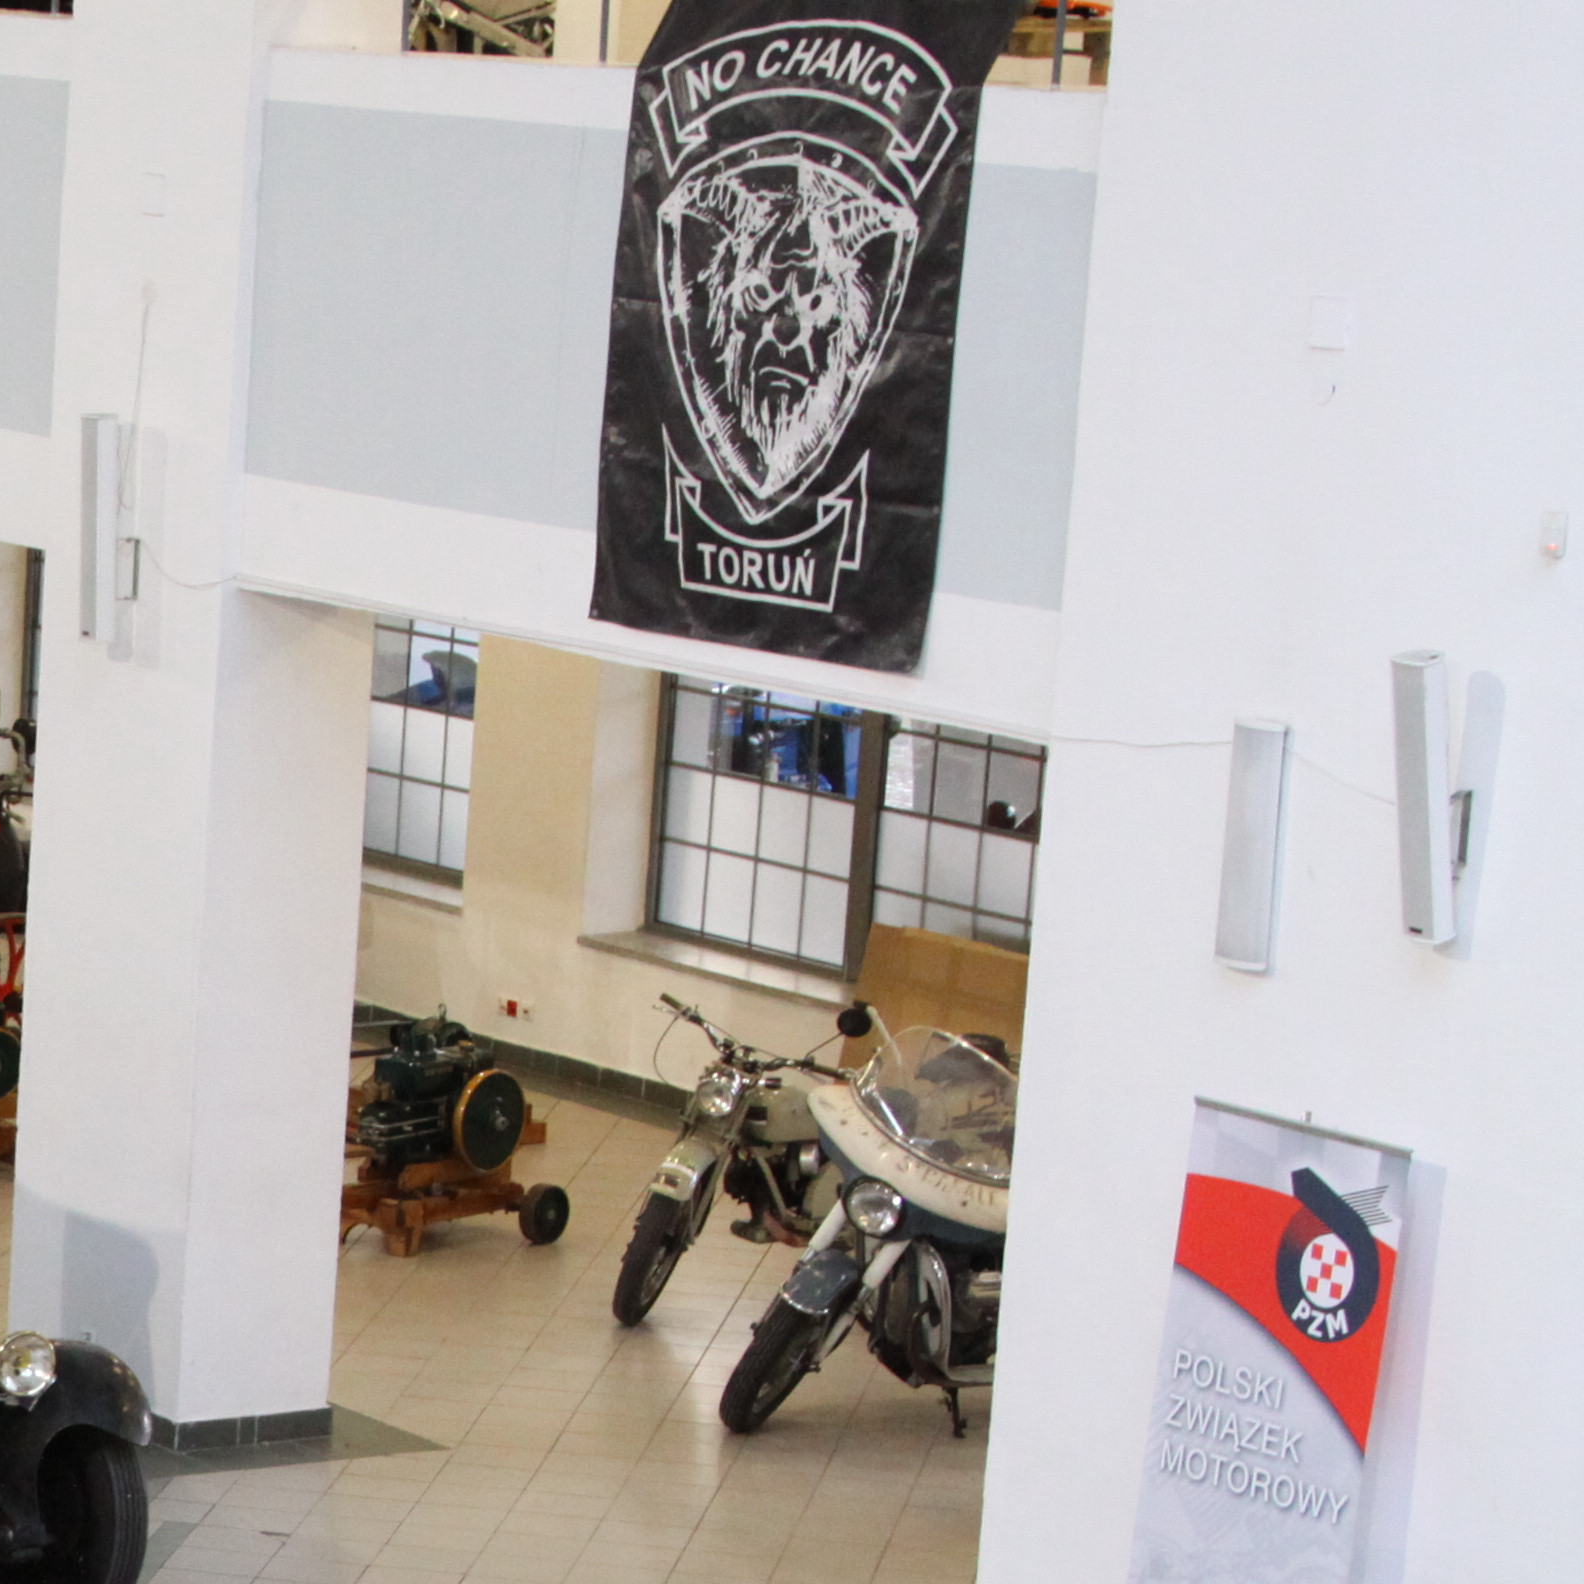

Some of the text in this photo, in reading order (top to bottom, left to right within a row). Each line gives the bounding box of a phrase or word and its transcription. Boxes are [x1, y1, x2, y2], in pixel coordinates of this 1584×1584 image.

[685, 38, 917, 114] NO CHANCE
[697, 542, 815, 596] TORUŃ
[1291, 1298, 1349, 1340] PZM
[1173, 1349, 1283, 1410] POLSKI
[1164, 1394, 1303, 1464] ZWIĄZEK
[1160, 1438, 1349, 1525] MOTOROWY
